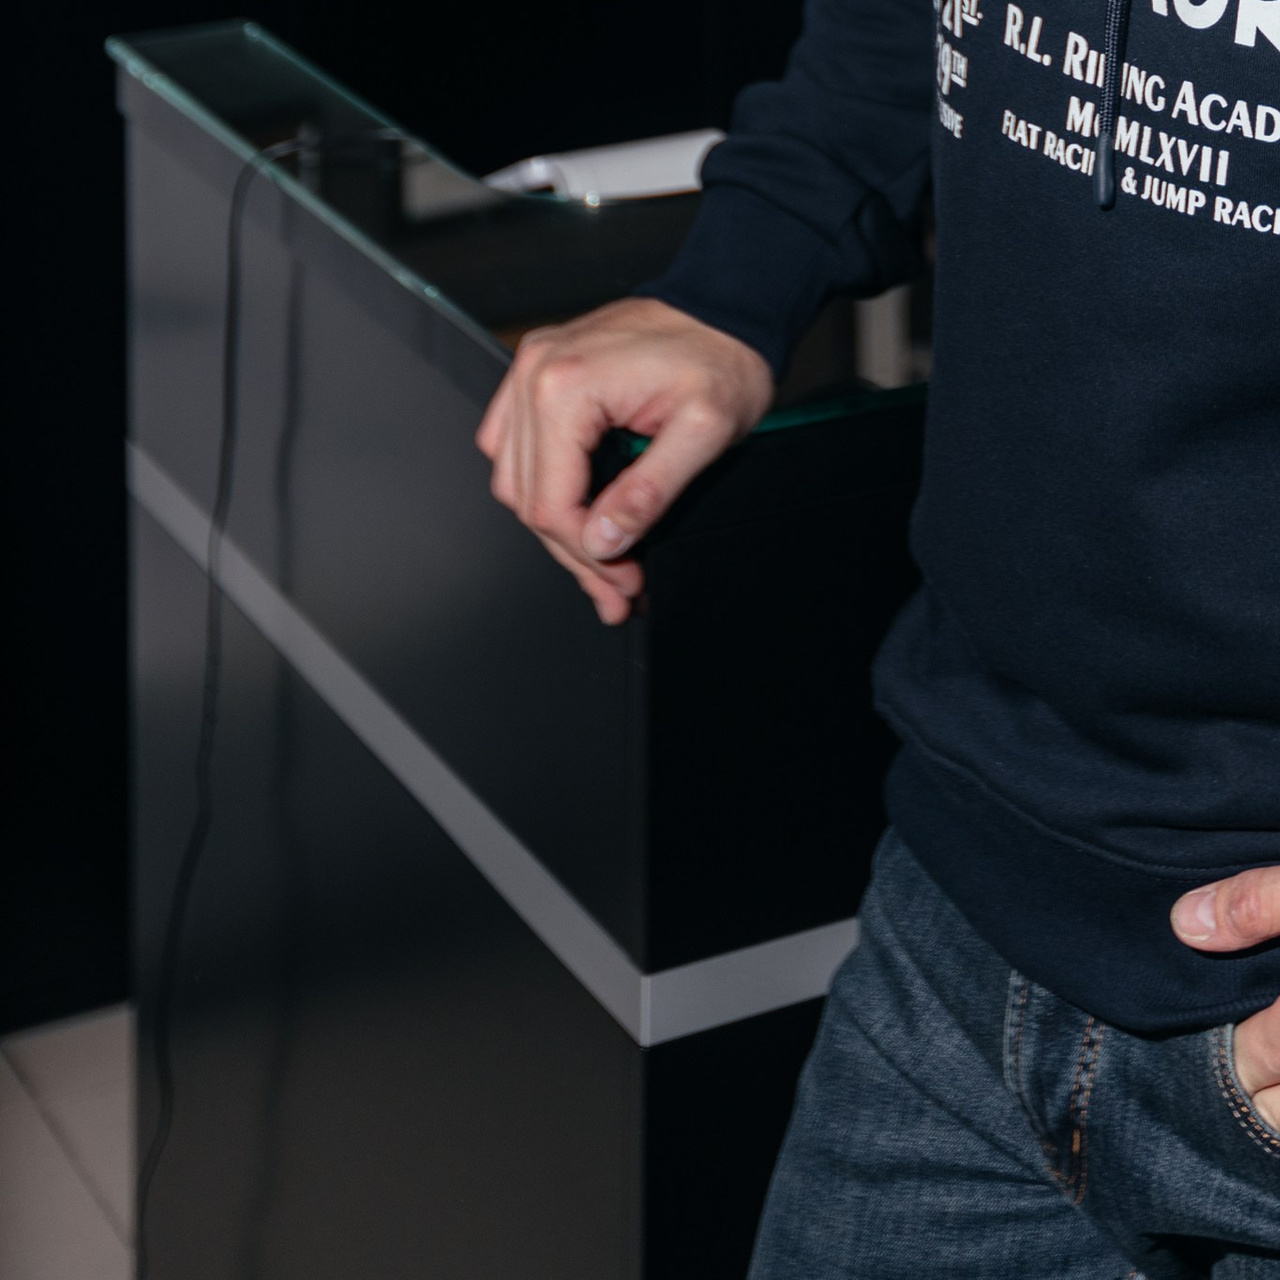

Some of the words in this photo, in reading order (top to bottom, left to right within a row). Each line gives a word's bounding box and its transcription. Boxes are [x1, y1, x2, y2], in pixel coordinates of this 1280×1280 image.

[1004, 3, 1052, 66] R.L.
[1002, 109, 1042, 150] FLAT
[1121, 167, 1138, 195] &
[1141, 175, 1207, 216] JUMP
